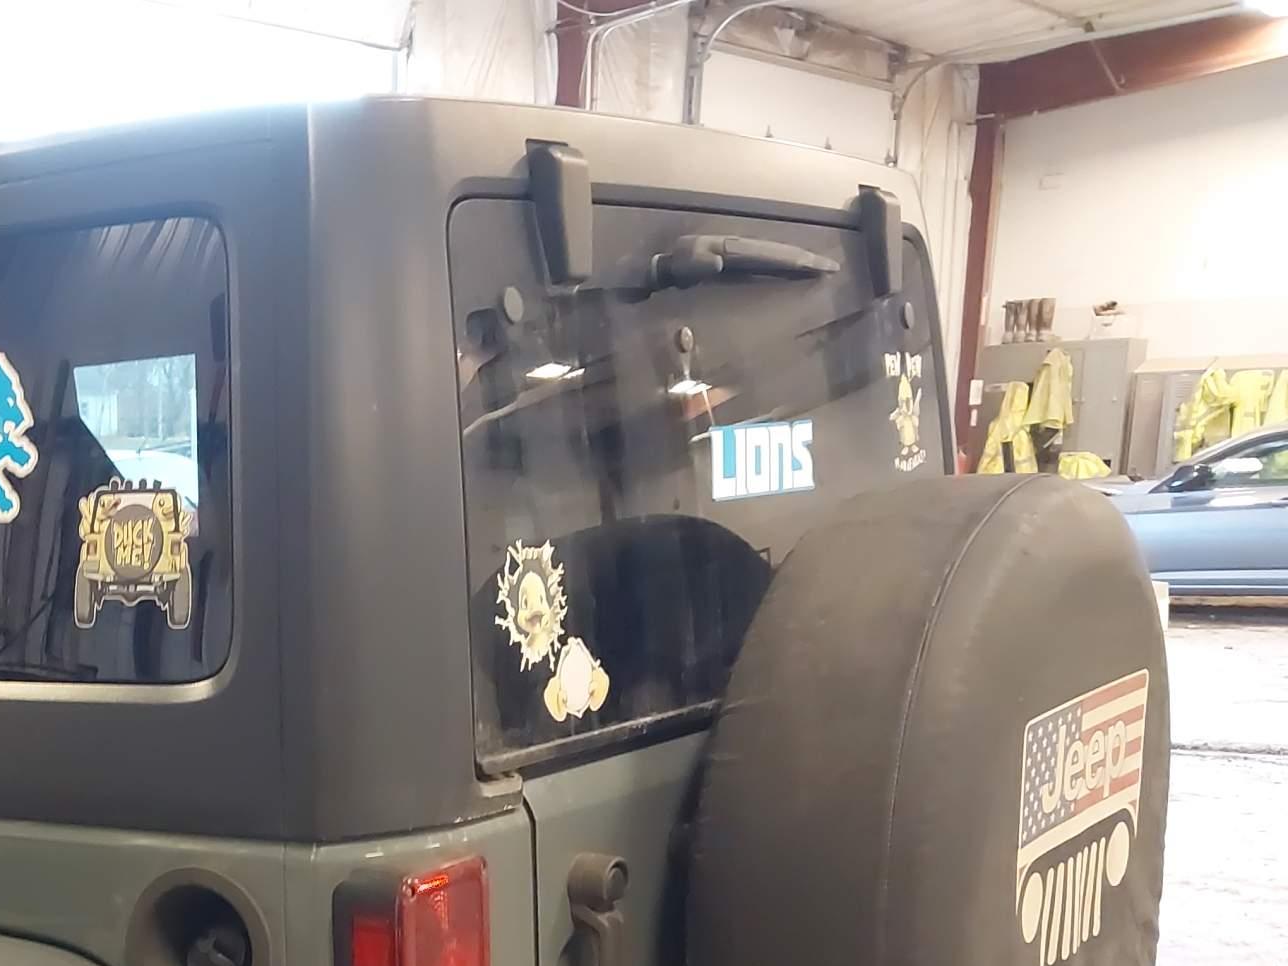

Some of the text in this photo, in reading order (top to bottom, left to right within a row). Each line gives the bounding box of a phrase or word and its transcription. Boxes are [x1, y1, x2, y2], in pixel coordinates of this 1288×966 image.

[709, 418, 815, 501] LIONS
[113, 518, 154, 549] DUCK
[116, 544, 152, 571] ME!
[1041, 719, 1128, 814] Jeep
